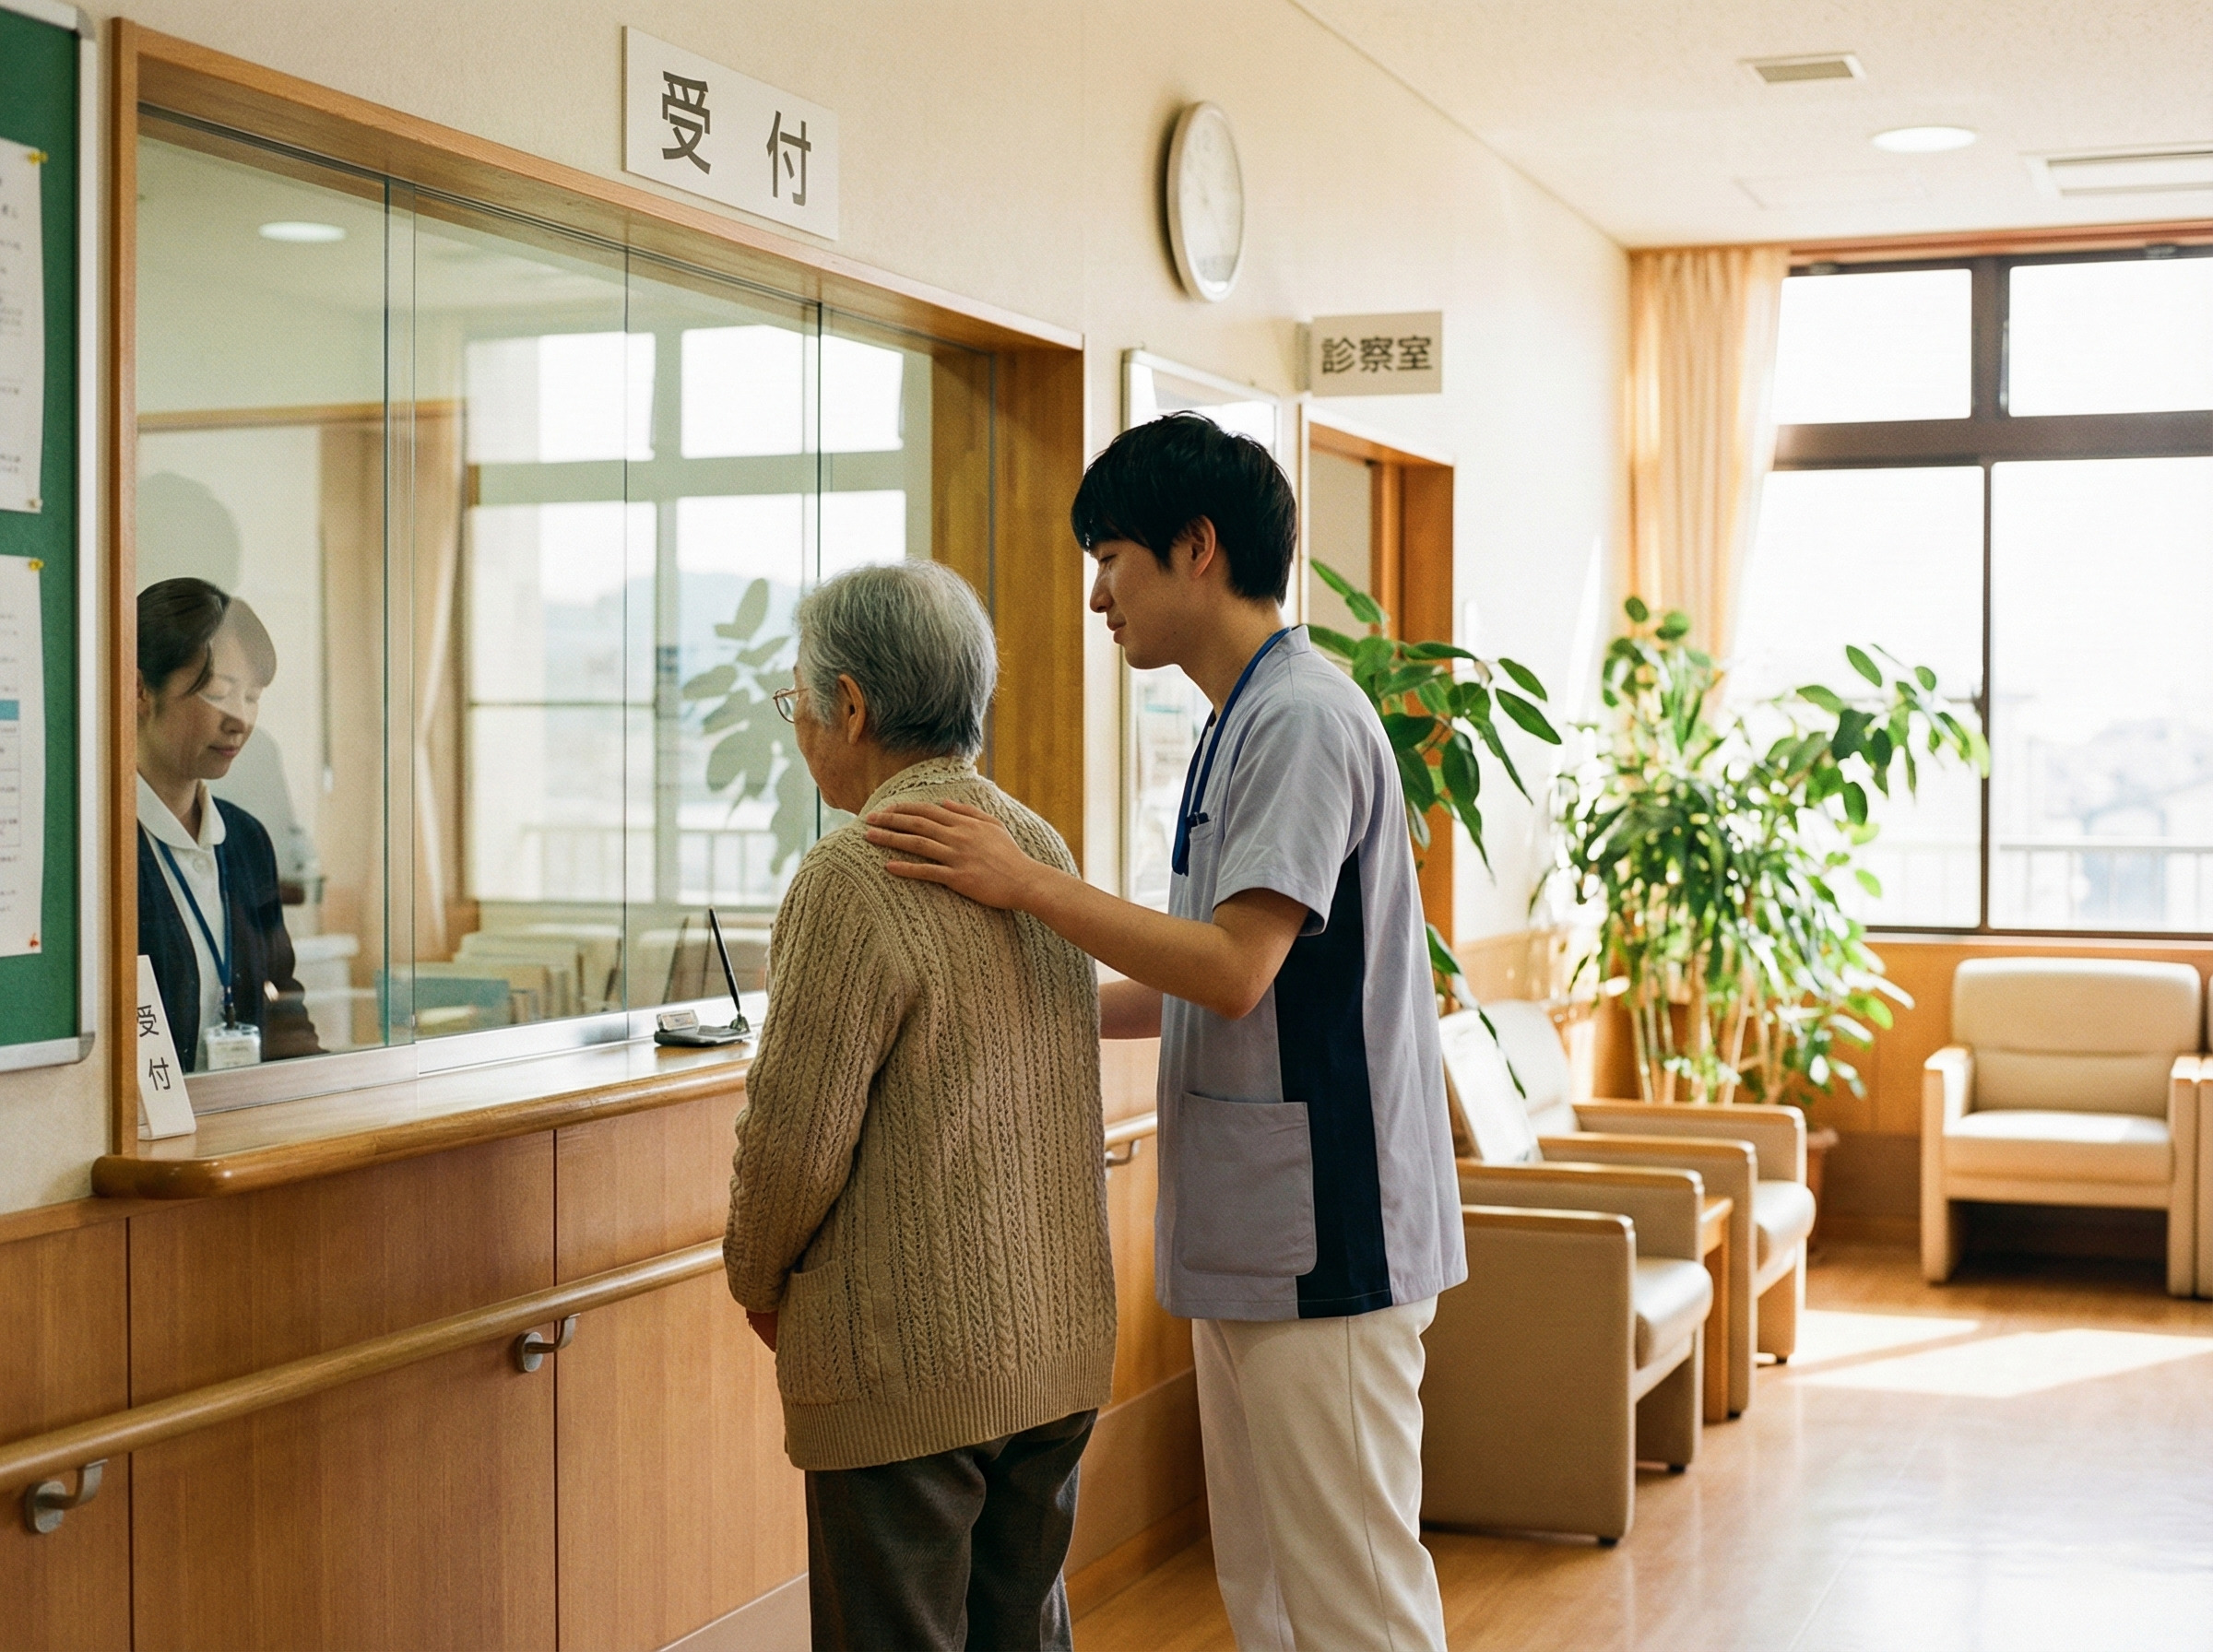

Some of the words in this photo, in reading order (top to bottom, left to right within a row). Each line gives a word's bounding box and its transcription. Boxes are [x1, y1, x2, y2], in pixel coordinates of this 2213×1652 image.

[661, 70, 811, 206] 受付
[1321, 336, 1432, 374] 診察室
[136, 1004, 172, 1092] 受付
